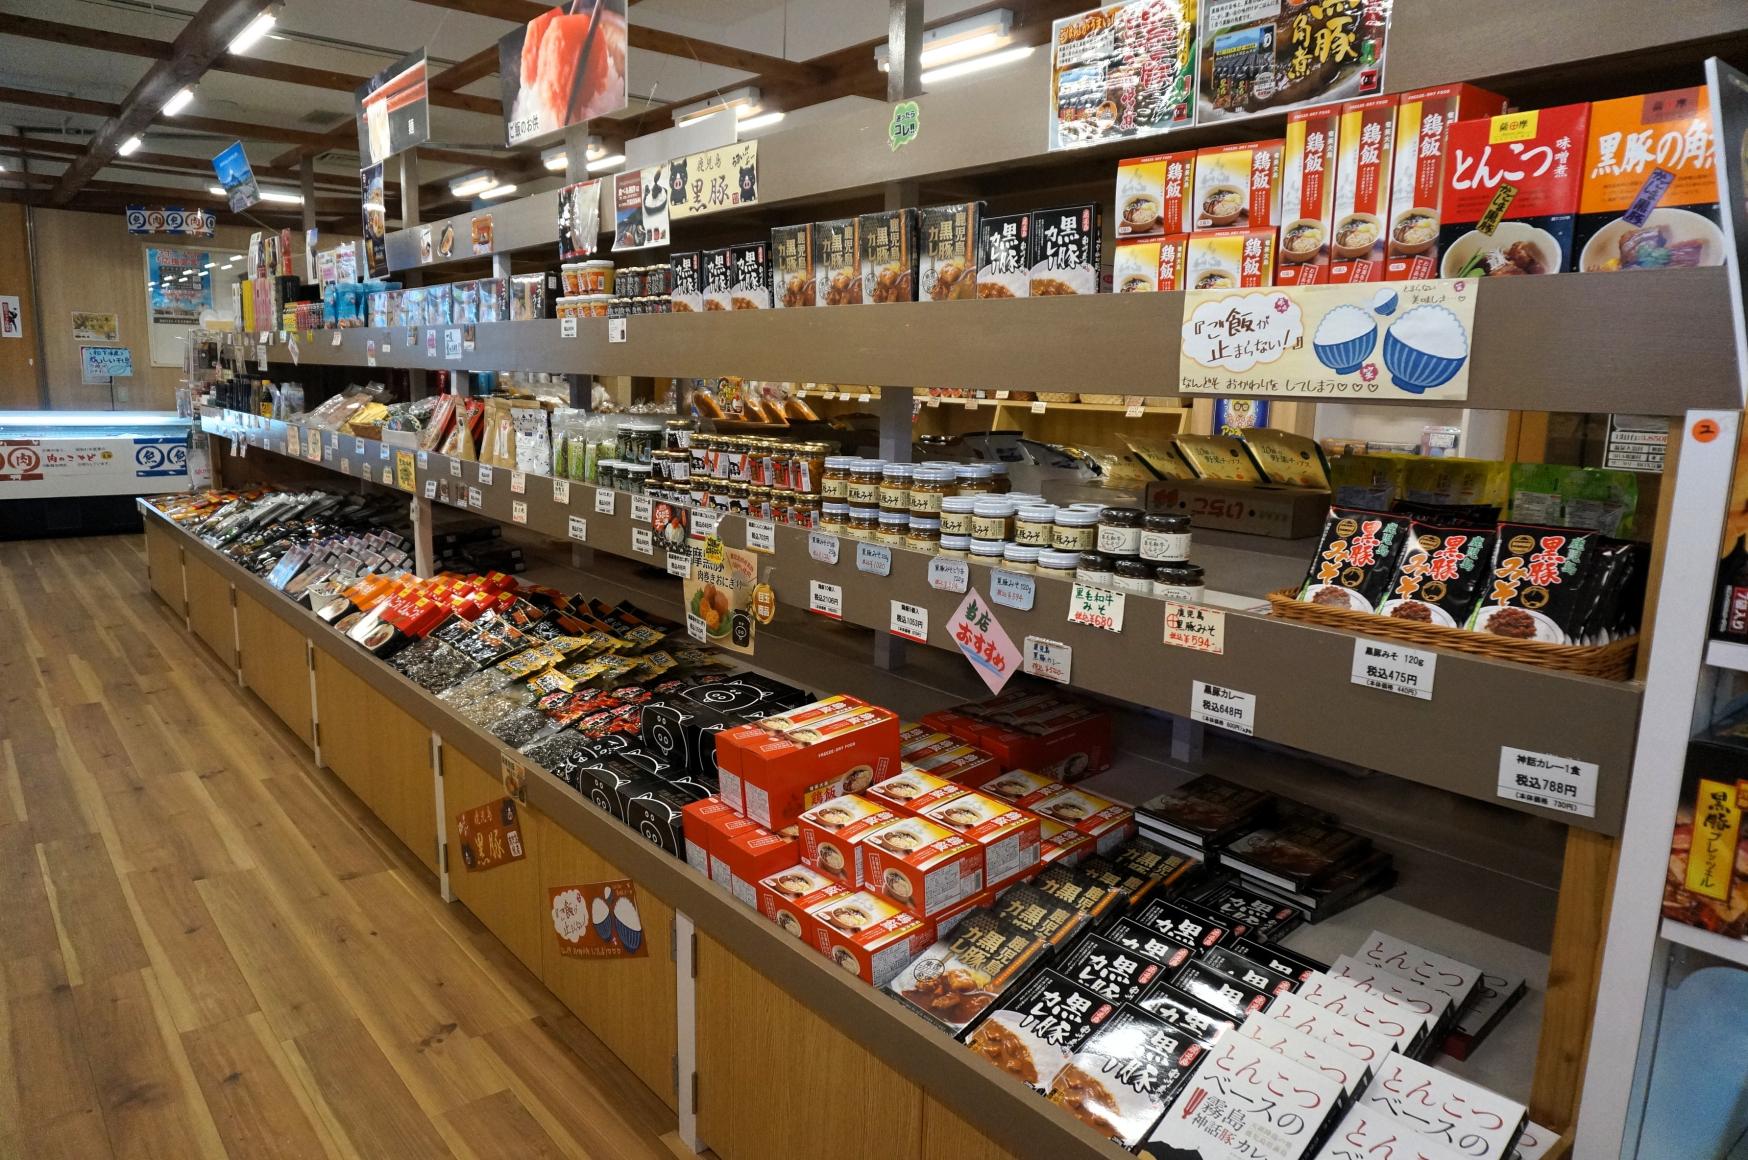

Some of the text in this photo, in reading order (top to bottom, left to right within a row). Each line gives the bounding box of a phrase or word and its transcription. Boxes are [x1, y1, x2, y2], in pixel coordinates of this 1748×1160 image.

[1288, 14, 1314, 79] 角煮
[508, 116, 539, 139] ご飯のお供
[1360, 122, 1382, 165] 鶏飯
[1420, 113, 1444, 158] 鶏飯
[1252, 151, 1271, 189] 鶏飯
[1305, 131, 1325, 173] 鶏飯
[1452, 142, 1554, 190] とんこつ
[689, 174, 729, 212] 黒豚
[1166, 162, 1183, 198] 鶏飯
[786, 239, 797, 272] 黒豚
[831, 234, 843, 269] 黒豚
[876, 227, 889, 265] 黒豚
[939, 220, 953, 261] 黒豚
[1000, 222, 1019, 274] 黒豚
[1058, 215, 1080, 270] 黒豚
[1243, 237, 1262, 276] 鶏飯
[743, 251, 758, 289] 黒豚
[1160, 244, 1175, 280] 鶏飯
[1317, 540, 1350, 586] みそ
[1350, 520, 1382, 567] 黒豚
[1431, 535, 1468, 581] 黒豚
[1527, 535, 1566, 586] 黒豚
[1075, 587, 1114, 606] 黒毛和牛
[1395, 553, 1432, 600] みそ
[1490, 556, 1529, 607] みそ
[963, 599, 992, 634] 当店
[1083, 602, 1106, 616] みそ
[1176, 619, 1216, 637] 黒豚みそ
[1177, 608, 1204, 621] 鹿児島
[956, 622, 1006, 672] おすすめ
[1365, 646, 1425, 667] 黒豚みそ 120g
[1203, 684, 1245, 700] 黒豚カレー
[1366, 665, 1418, 686] 税込475円
[1202, 699, 1243, 719] 税込648円
[1516, 753, 1581, 777] 神話カレー1食
[1515, 773, 1578, 798] 税込788円
[959, 929, 1005, 969] 黒豚
[982, 935, 1031, 976] 鹿児島
[1365, 940, 1465, 988] とんこつ
[1035, 991, 1093, 1047] 黒豚
[1216, 1044, 1321, 1109] とんこつ
[1201, 1094, 1247, 1132] 霧島
[1203, 1075, 1305, 1136] ベースの
[1383, 1066, 1504, 1131] とんこつ
[1371, 1096, 1490, 1157] ベースの
